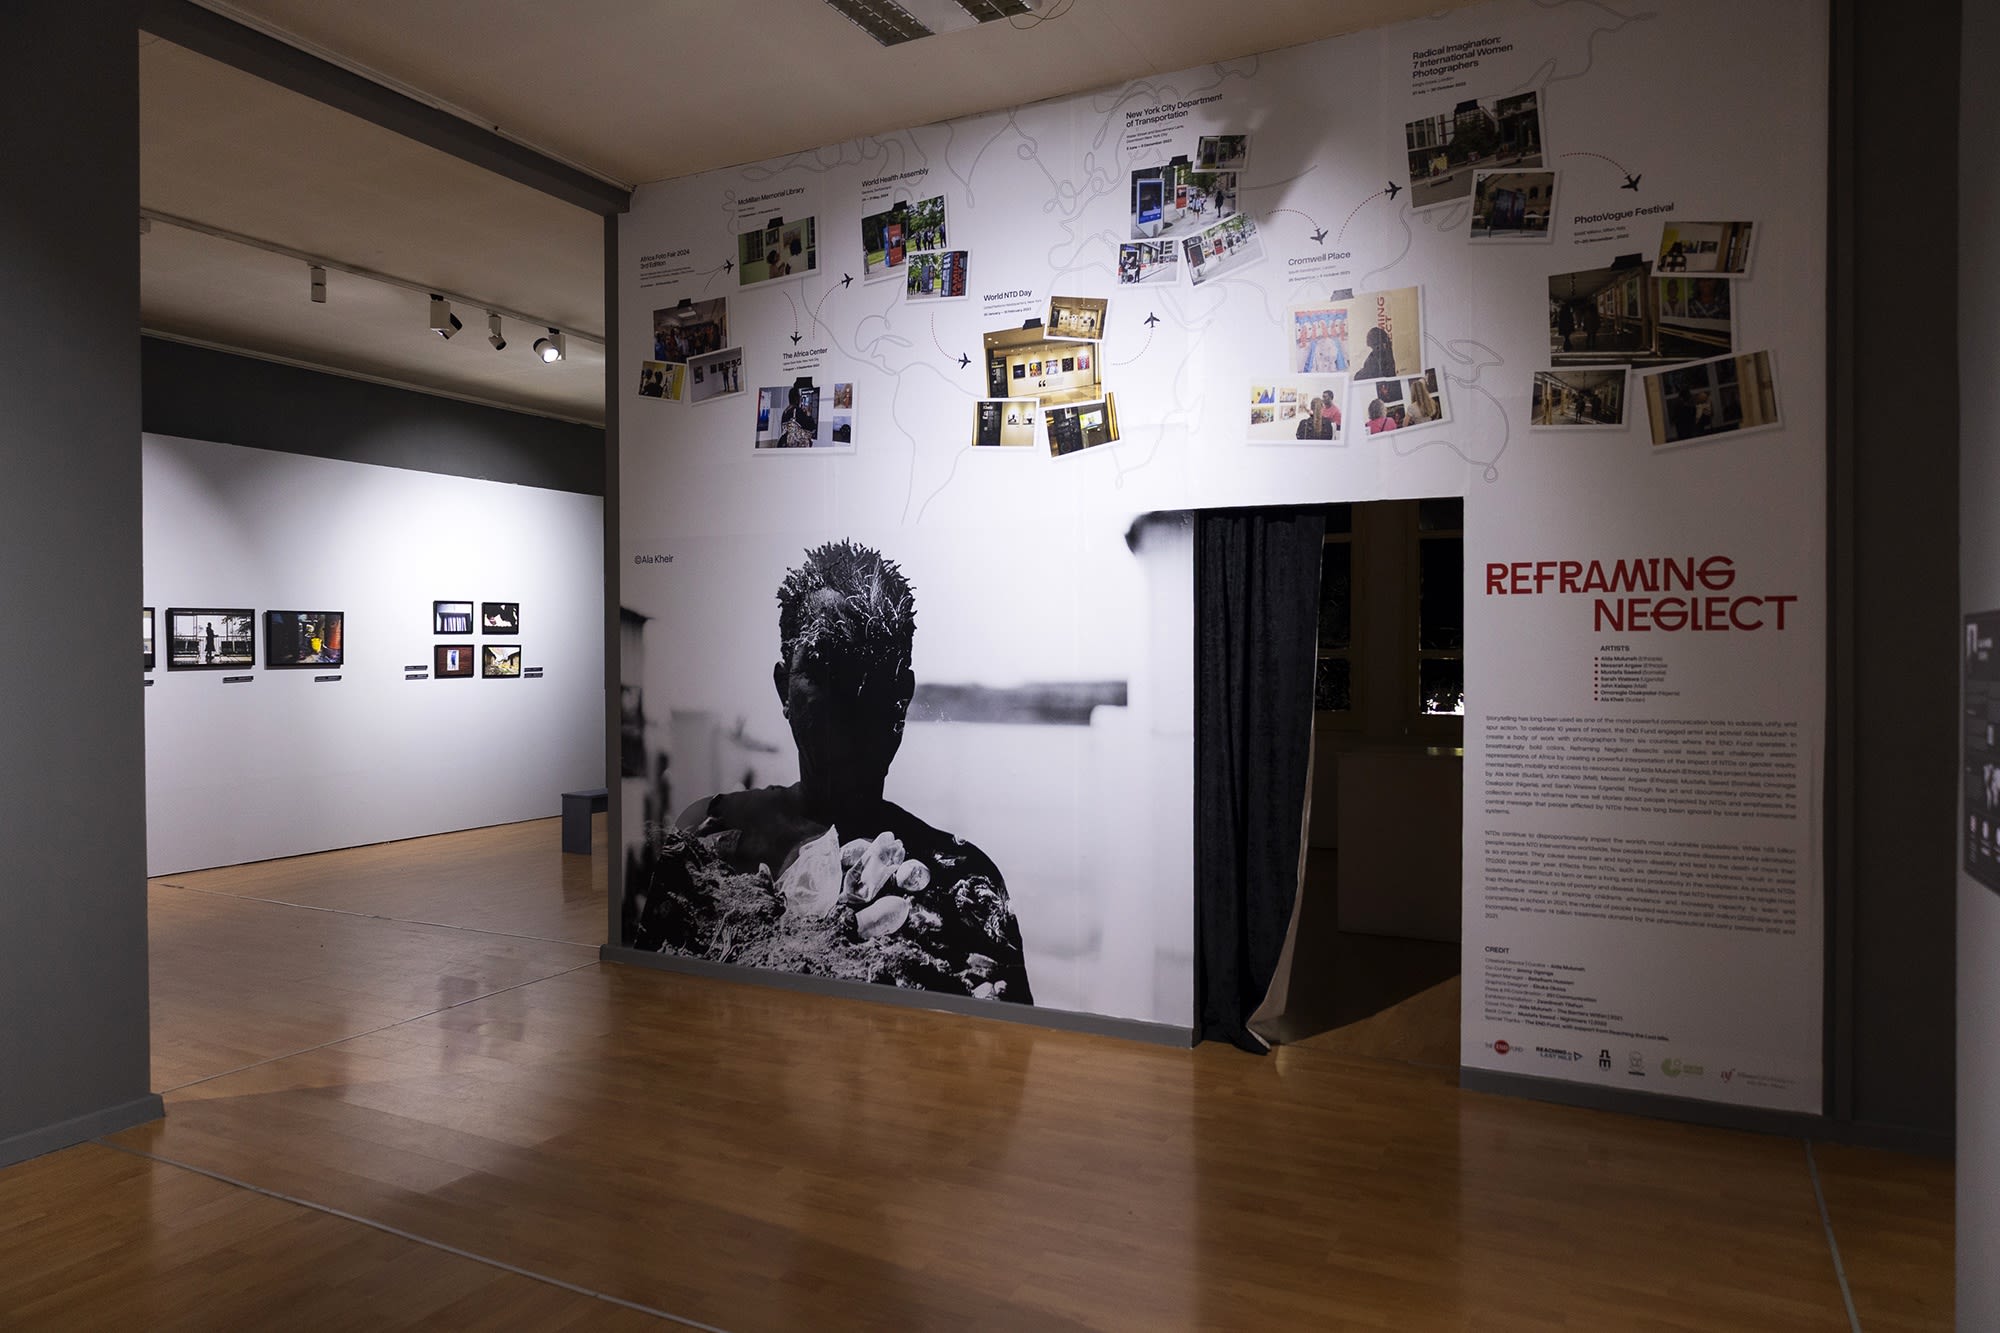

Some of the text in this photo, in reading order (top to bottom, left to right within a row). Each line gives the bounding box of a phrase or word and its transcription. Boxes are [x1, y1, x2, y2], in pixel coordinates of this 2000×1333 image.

[1412, 36, 1502, 60] Radical Imagination:
[1412, 44, 1514, 70] 7 International Women
[1412, 60, 1479, 79] Photographers
[1126, 93, 1223, 120] New York City Department
[1126, 110, 1189, 128] of Transportation
[861, 167, 929, 188] World Health Assembly
[761, 190, 786, 201] Memorial
[786, 187, 805, 196] Library
[1574, 202, 1674, 224] PhotoVogue Festival
[1288, 252, 1351, 266] Cromwell Place
[984, 290, 1033, 301] World NTD Day
[794, 350, 809, 358] Africa
[810, 348, 828, 356] Center
[634, 554, 674, 564] ©Ala Kheir
[1486, 556, 1735, 594] REFRAMING
[1594, 596, 1798, 632] NEGLECT
[1485, 946, 1510, 954] CREDIT
[1535, 1046, 1568, 1056] REACHING
